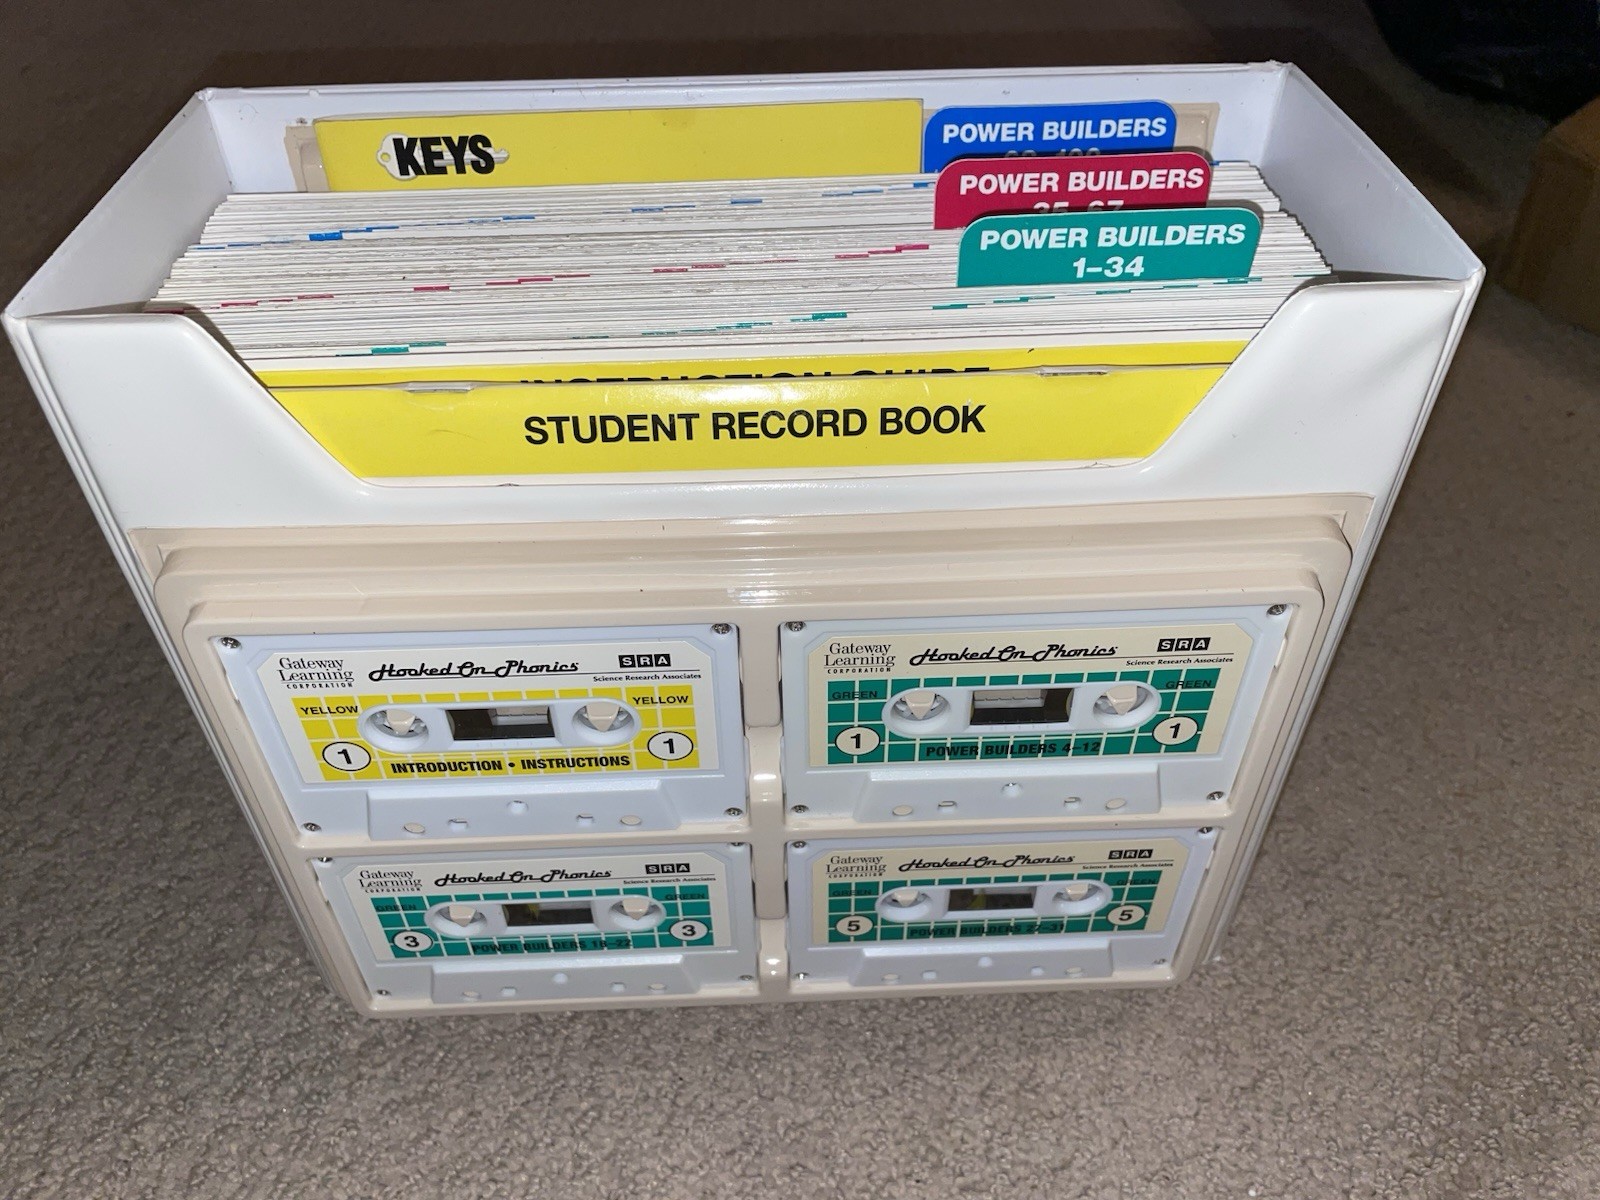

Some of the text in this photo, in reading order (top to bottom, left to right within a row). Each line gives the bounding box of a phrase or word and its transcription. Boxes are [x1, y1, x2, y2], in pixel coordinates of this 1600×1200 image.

[942, 117, 1167, 144] POWER BUILDERS
[392, 134, 495, 176] KEYS
[960, 168, 1204, 195] POWER BUILDERS
[980, 224, 1246, 251] POWER BUILDERS
[1072, 255, 1145, 278] 1-34
[524, 404, 987, 445] STUDENT RECORD BOOK
[829, 642, 892, 655] Gateway
[1157, 637, 1211, 652] SRA
[619, 653, 671, 668] SRA
[824, 654, 896, 667] Learning
[909, 644, 1118, 666] Hooked On Phonics
[279, 657, 344, 670] Gateway
[277, 669, 354, 682] Learning
[368, 660, 579, 681] Hooked On Phonics
[1165, 679, 1212, 689] GREEN
[632, 695, 689, 705] YELLOW
[832, 690, 878, 700] GREEN
[300, 705, 359, 715] YELLOW
[1169, 723, 1181, 739] 1
[662, 738, 675, 754] 1
[850, 733, 861, 749] 1
[926, 741, 1101, 757] POWER BUILDERS 4-12
[337, 748, 352, 765] 1
[390, 756, 631, 774] INTRODUCTION INSTRUCTIONS
[830, 855, 883, 866] Gateway
[1108, 849, 1153, 860] SRA
[645, 863, 690, 874] SRA
[826, 863, 887, 873] Learning
[898, 854, 1075, 872] Hooked On Phonics
[359, 869, 414, 880] Gateway
[434, 869, 611, 887] Hooked On Phonics
[358, 878, 422, 888] Learning
[1116, 878, 1157, 886] GREEN
[665, 893, 705, 901] GREEN
[832, 889, 872, 897] GREEN
[375, 904, 416, 912] GREEN
[1118, 909, 1133, 921] 5
[682, 924, 697, 937] 3
[847, 920, 860, 932] 5
[910, 927, 957, 938] POWER
[960, 924, 1022, 936] BUILDERS
[404, 936, 420, 948] 3
[472, 943, 518, 952] POWER
[523, 939, 587, 951] BUILDERS
